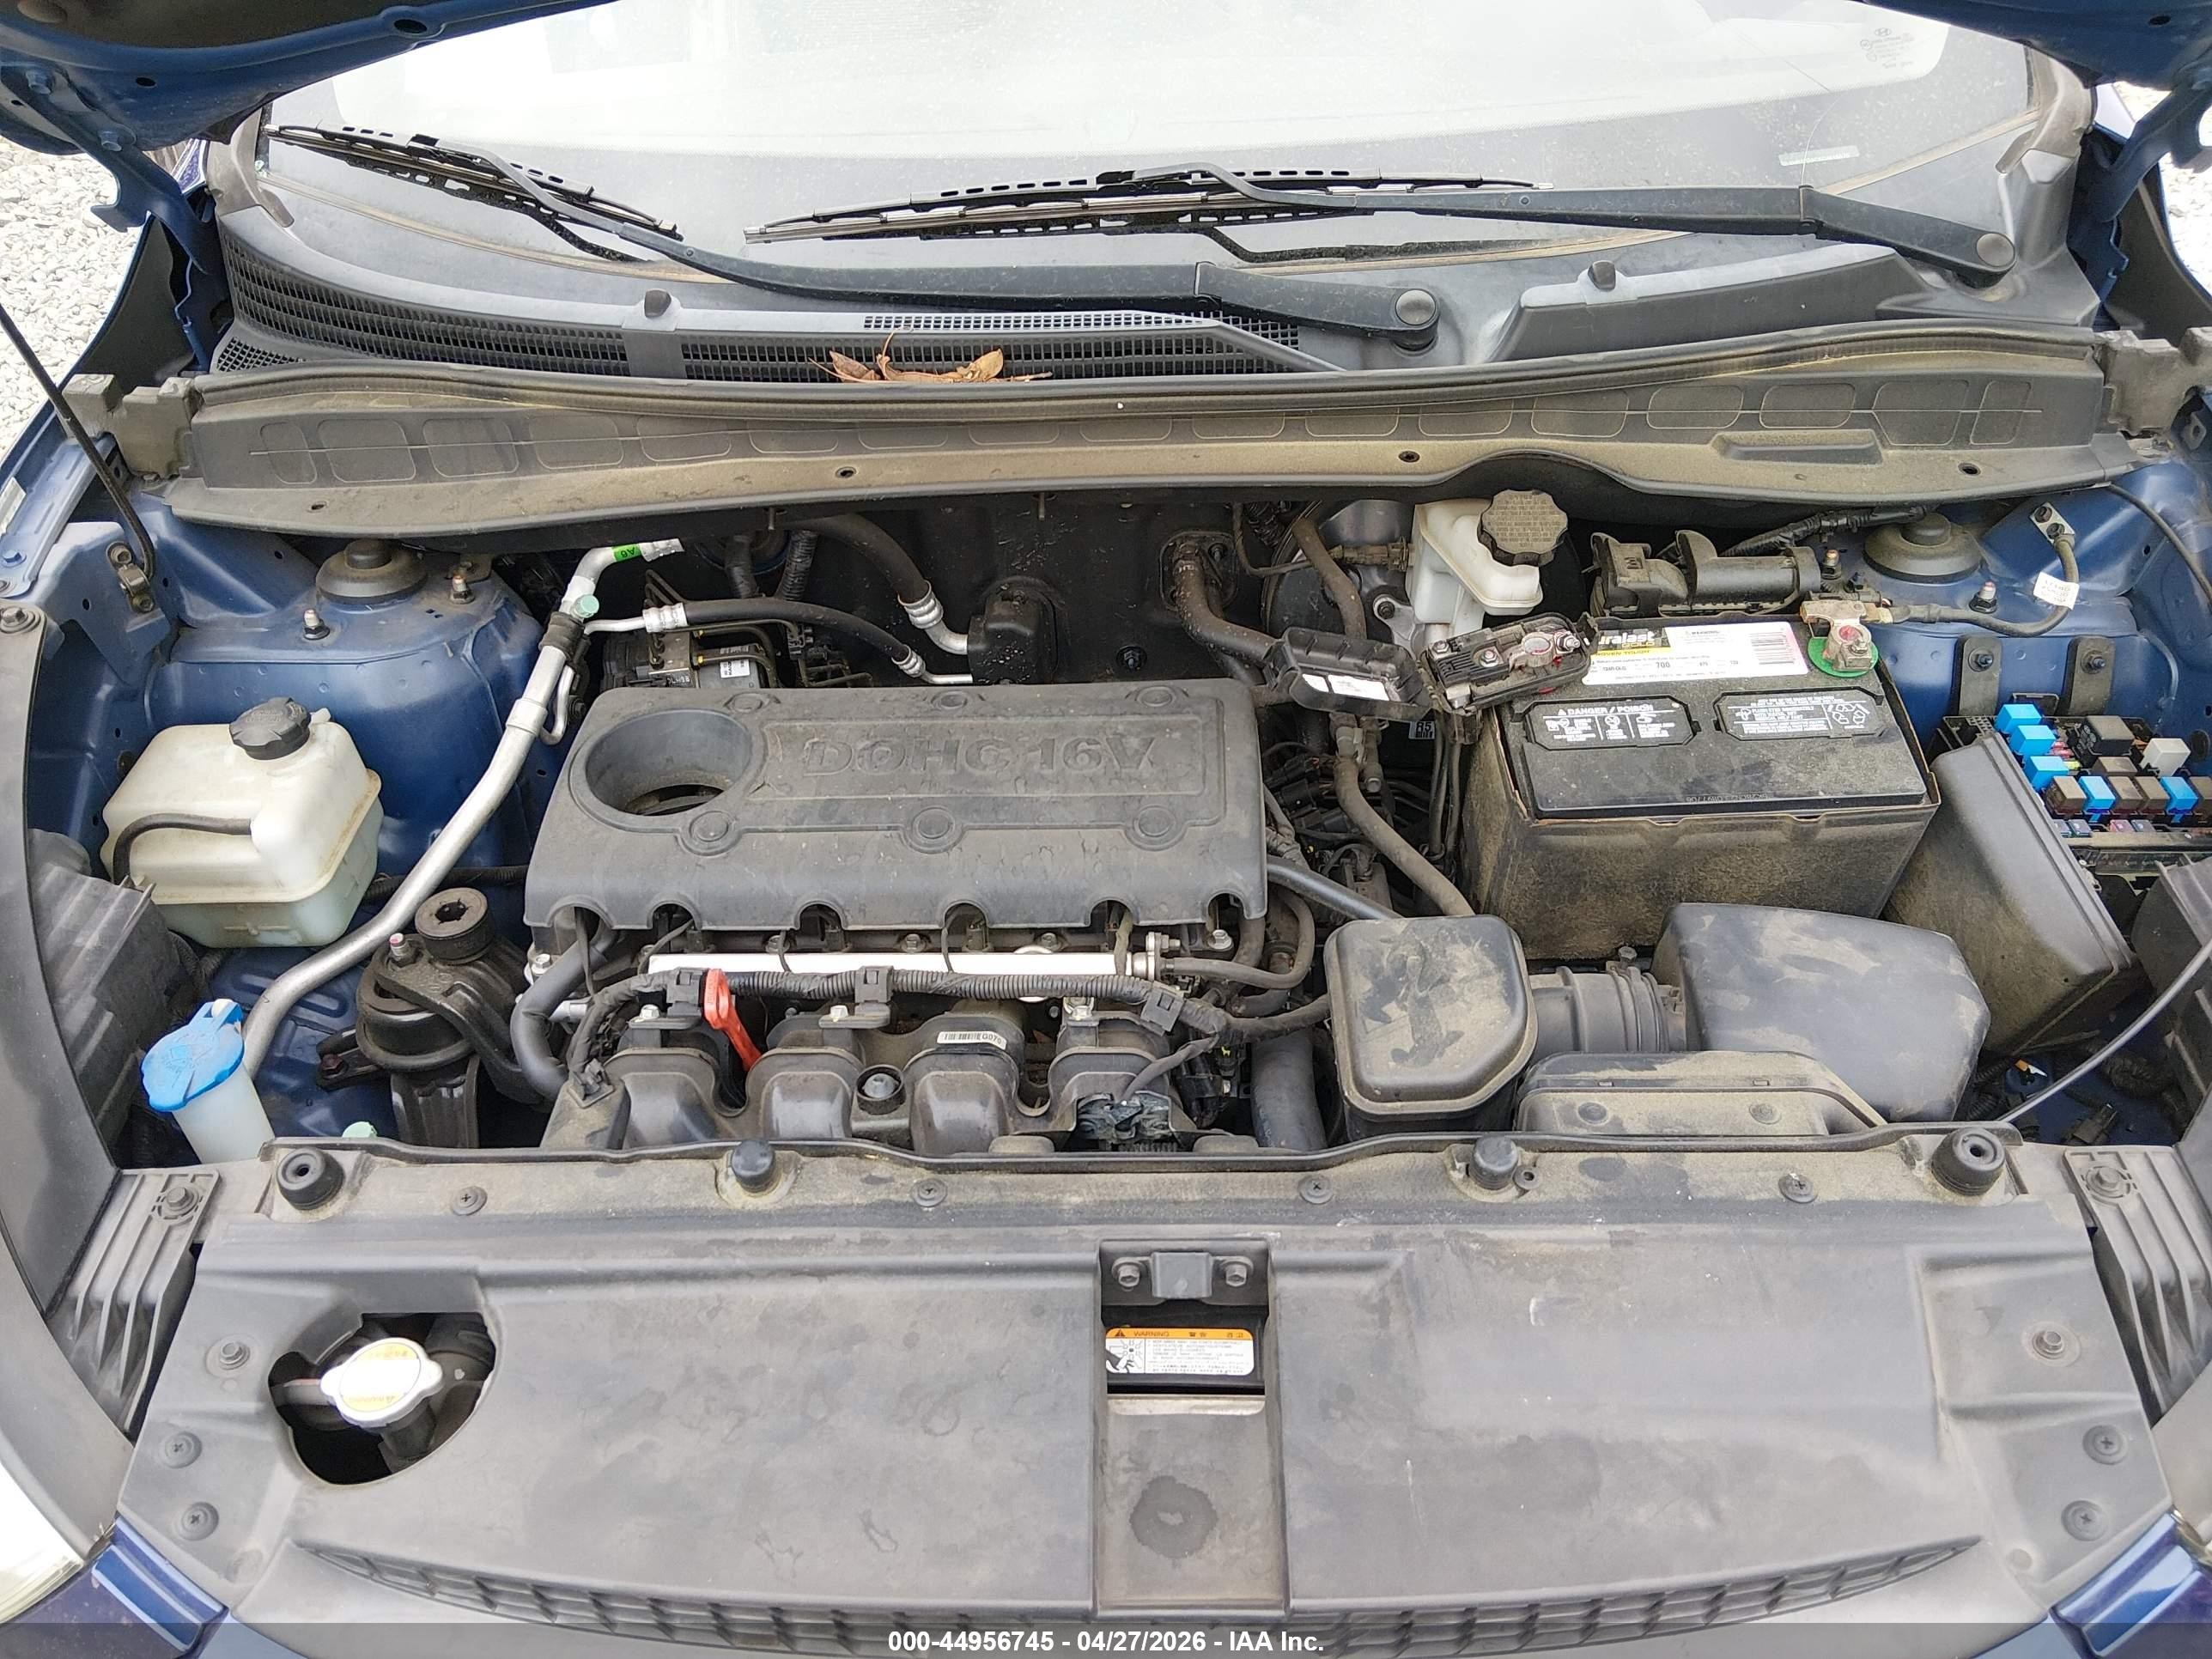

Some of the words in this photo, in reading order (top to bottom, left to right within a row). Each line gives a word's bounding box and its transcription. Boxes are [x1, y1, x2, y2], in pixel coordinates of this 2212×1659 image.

[1568, 707, 1607, 715] DANGER
[1618, 703, 1654, 714] POISON
[805, 738, 1012, 775] DOHC
[1028, 735, 1156, 774] 16V
